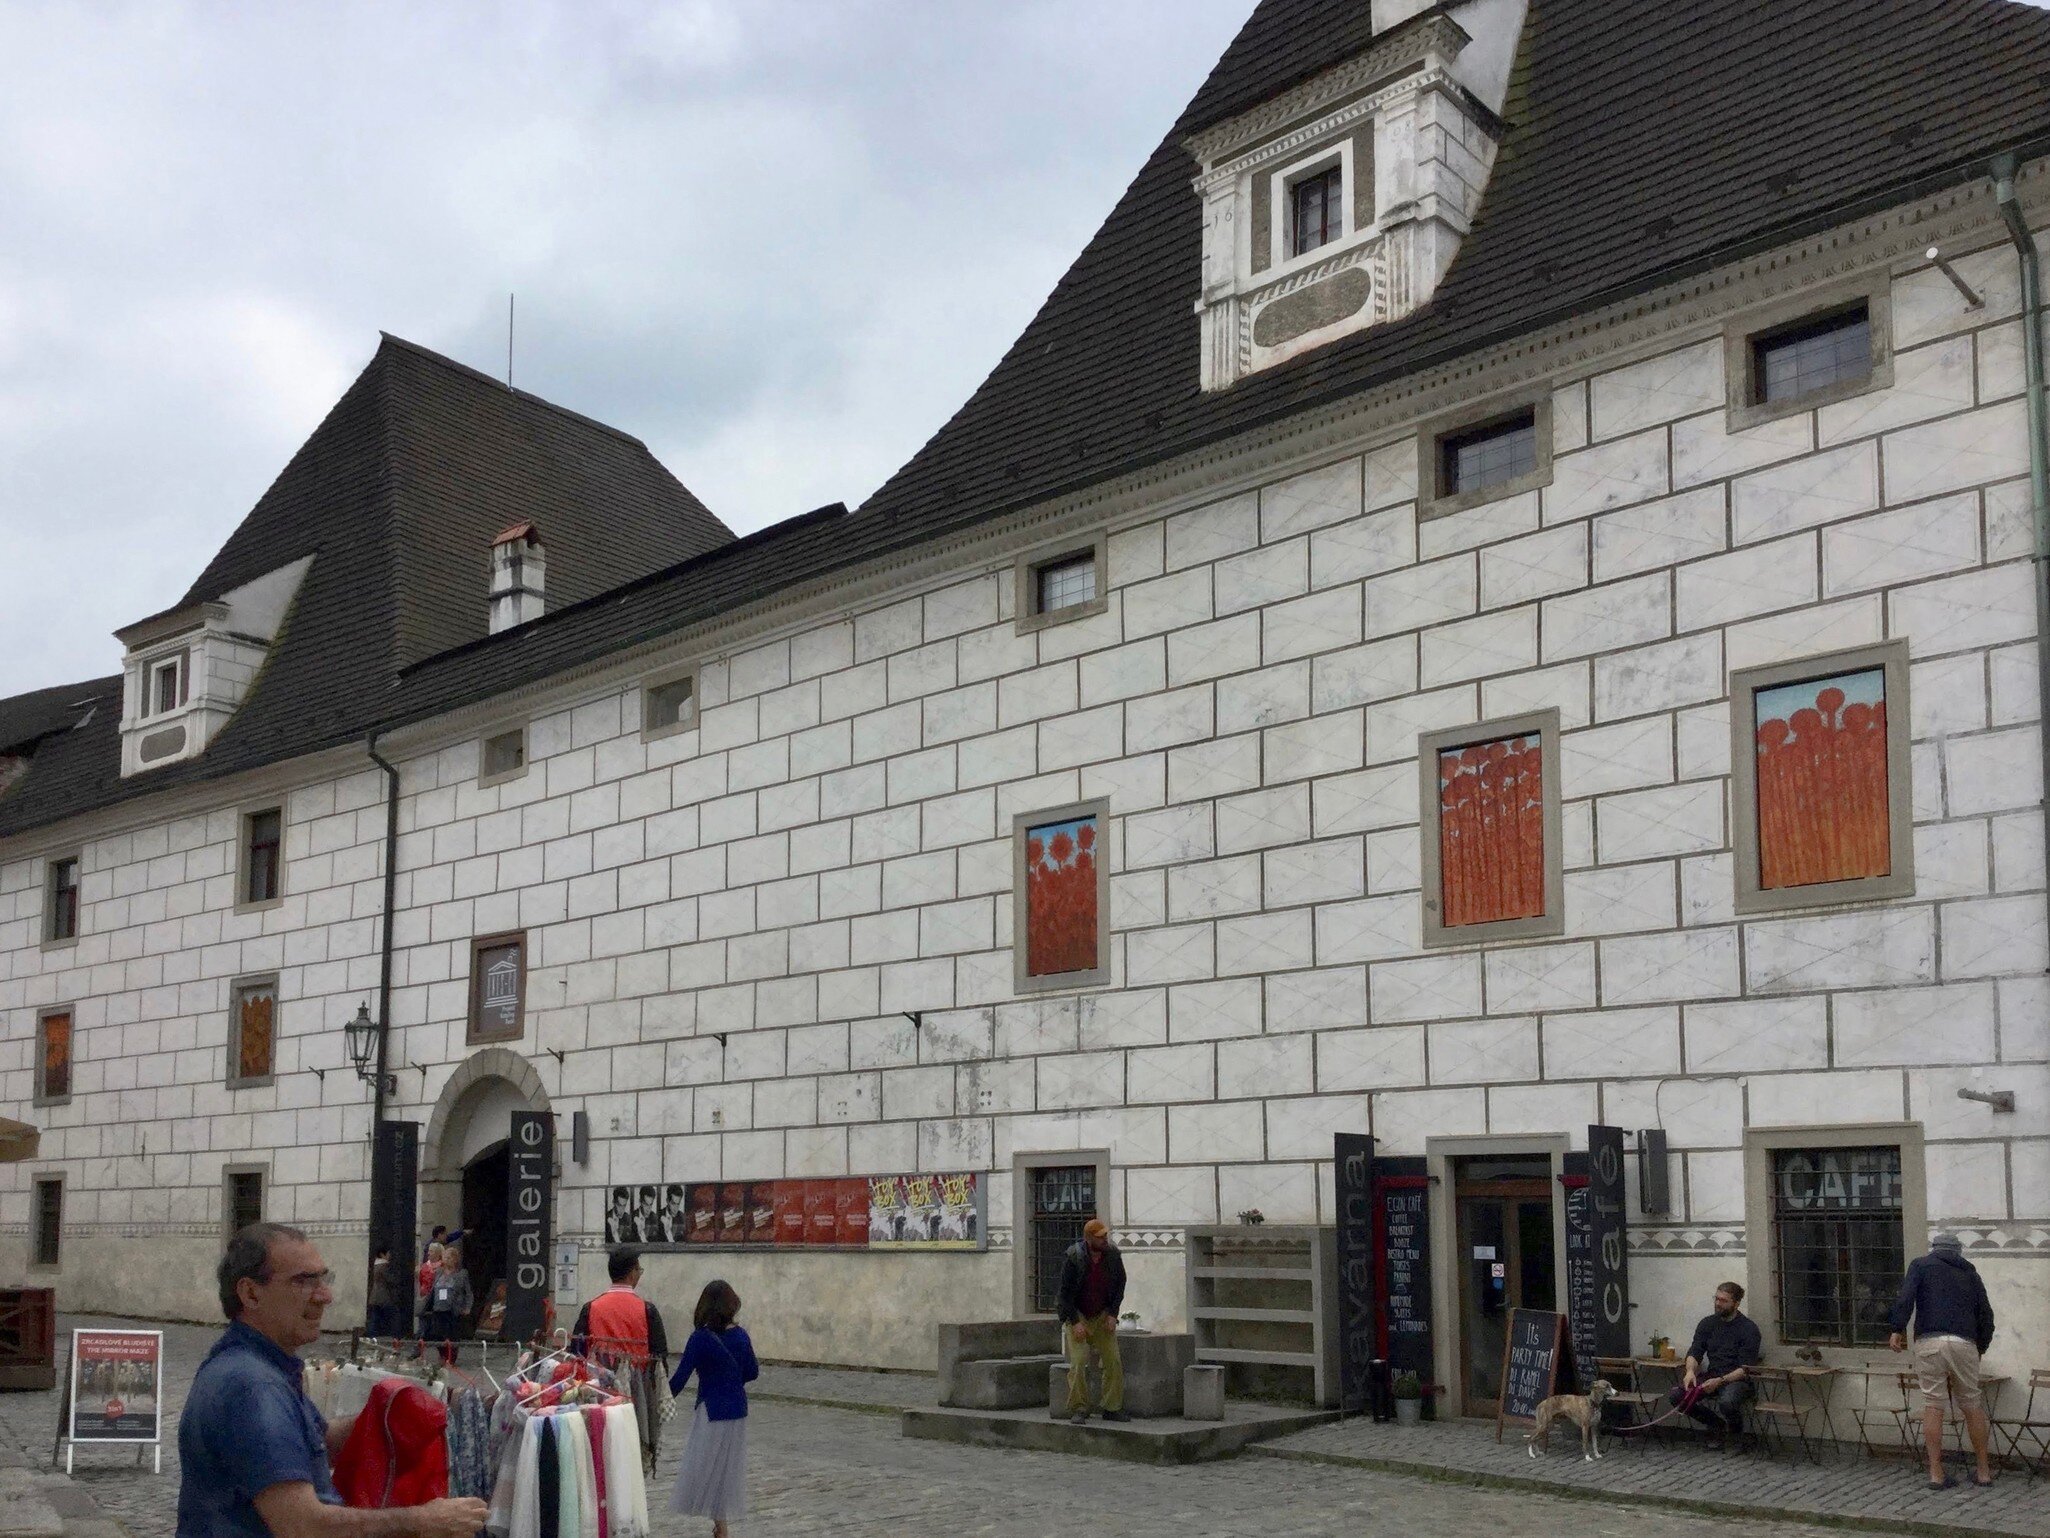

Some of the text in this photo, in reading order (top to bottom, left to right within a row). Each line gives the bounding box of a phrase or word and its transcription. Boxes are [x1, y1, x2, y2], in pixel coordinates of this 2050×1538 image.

[511, 1120, 546, 1290] galerie
[873, 1191, 897, 1208] BOX
[908, 1190, 932, 1208] BOX
[943, 1188, 969, 1206] BOX
[1594, 1144, 1623, 1324] café
[1511, 1346, 1533, 1366] PARTY
